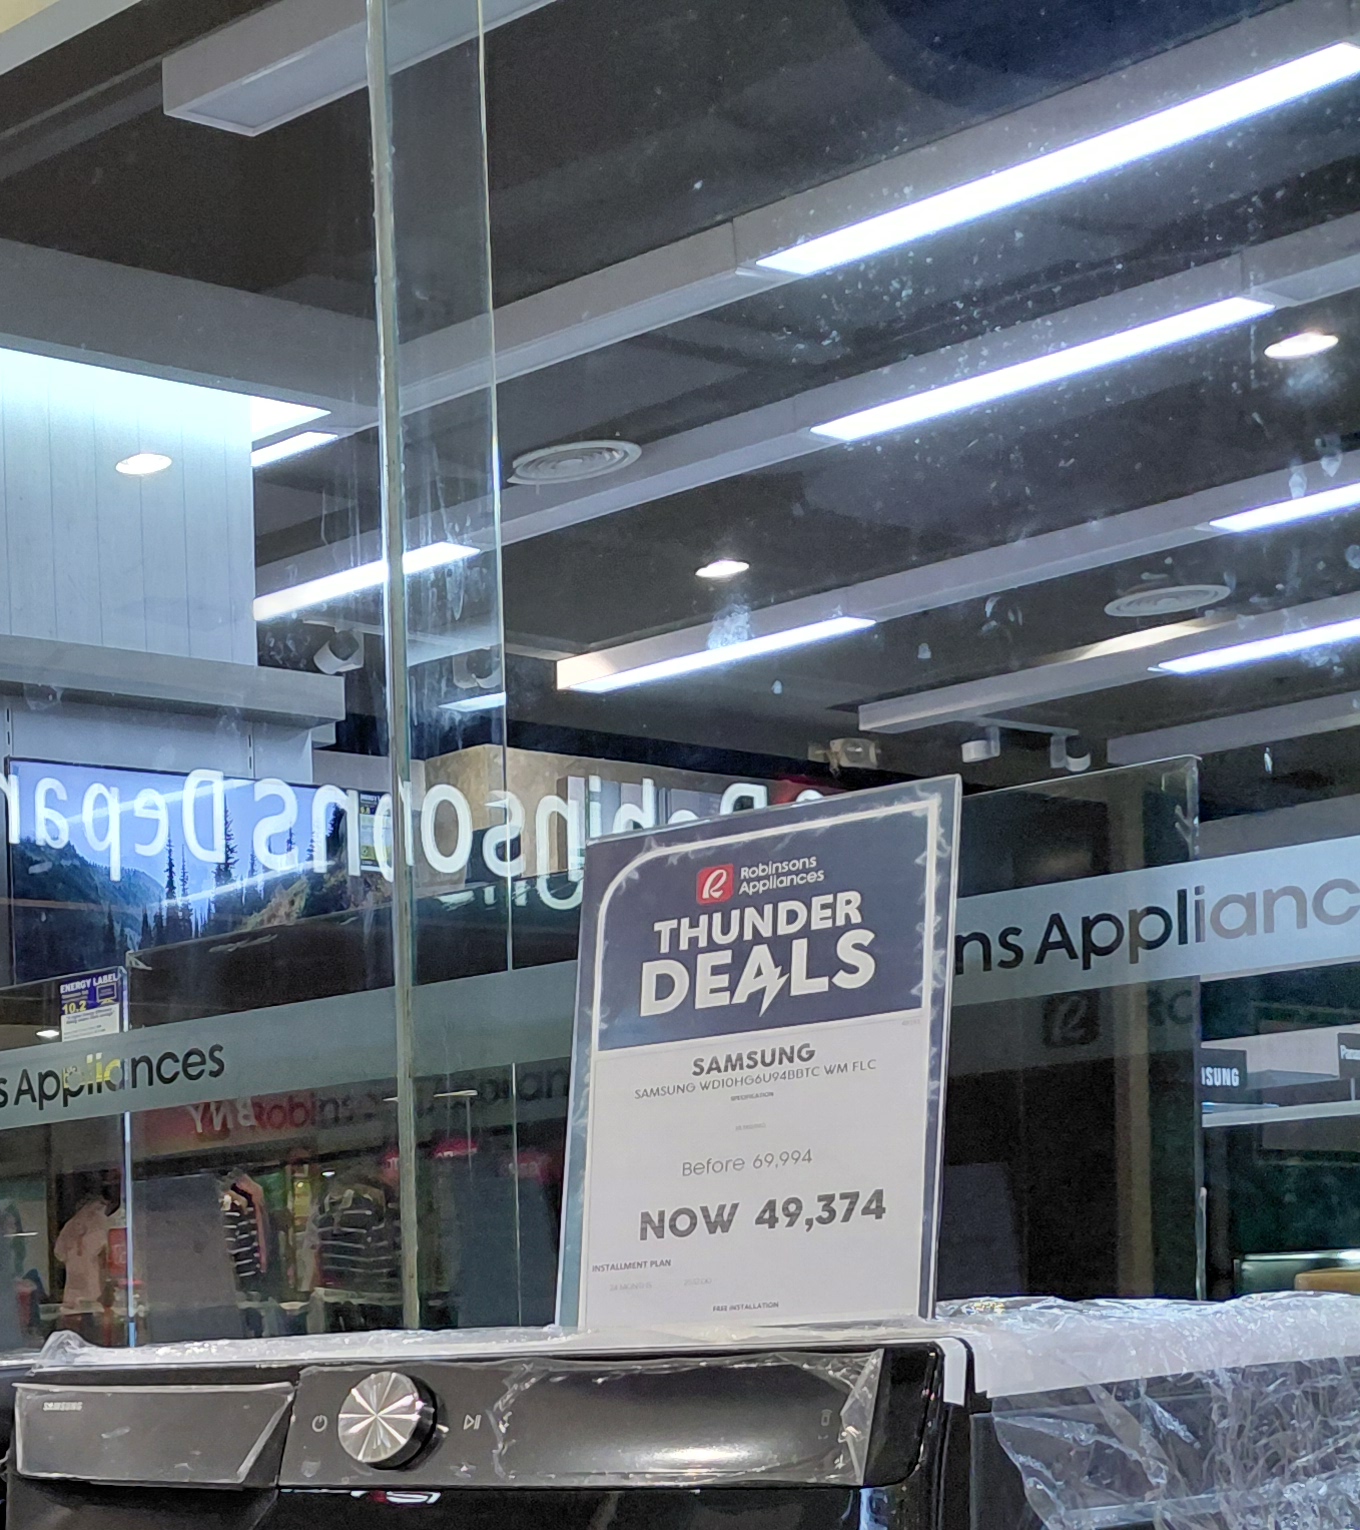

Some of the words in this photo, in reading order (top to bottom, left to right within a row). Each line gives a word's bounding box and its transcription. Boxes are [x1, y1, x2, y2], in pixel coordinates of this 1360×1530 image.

[738, 866, 826, 897] Appliances
[739, 853, 818, 881] Robinsons
[653, 889, 863, 955] THUNDER
[60, 978, 92, 994] ENERGY
[92, 973, 119, 987] LABEL
[640, 928, 877, 1018] DEALS
[691, 1042, 816, 1077] SAMSUNG
[13, 1042, 226, 1113] Appliances
[634, 1081, 697, 1100] SAMSUNG
[823, 1061, 849, 1076] WM
[851, 1058, 878, 1073] FLC
[681, 1154, 746, 1178] Before
[751, 1147, 813, 1173] 69,994
[640, 1202, 740, 1242] NOW
[754, 1188, 888, 1235] 49,374
[591, 1259, 648, 1274] INSTALLMENT
[649, 1258, 672, 1268] PLAN
